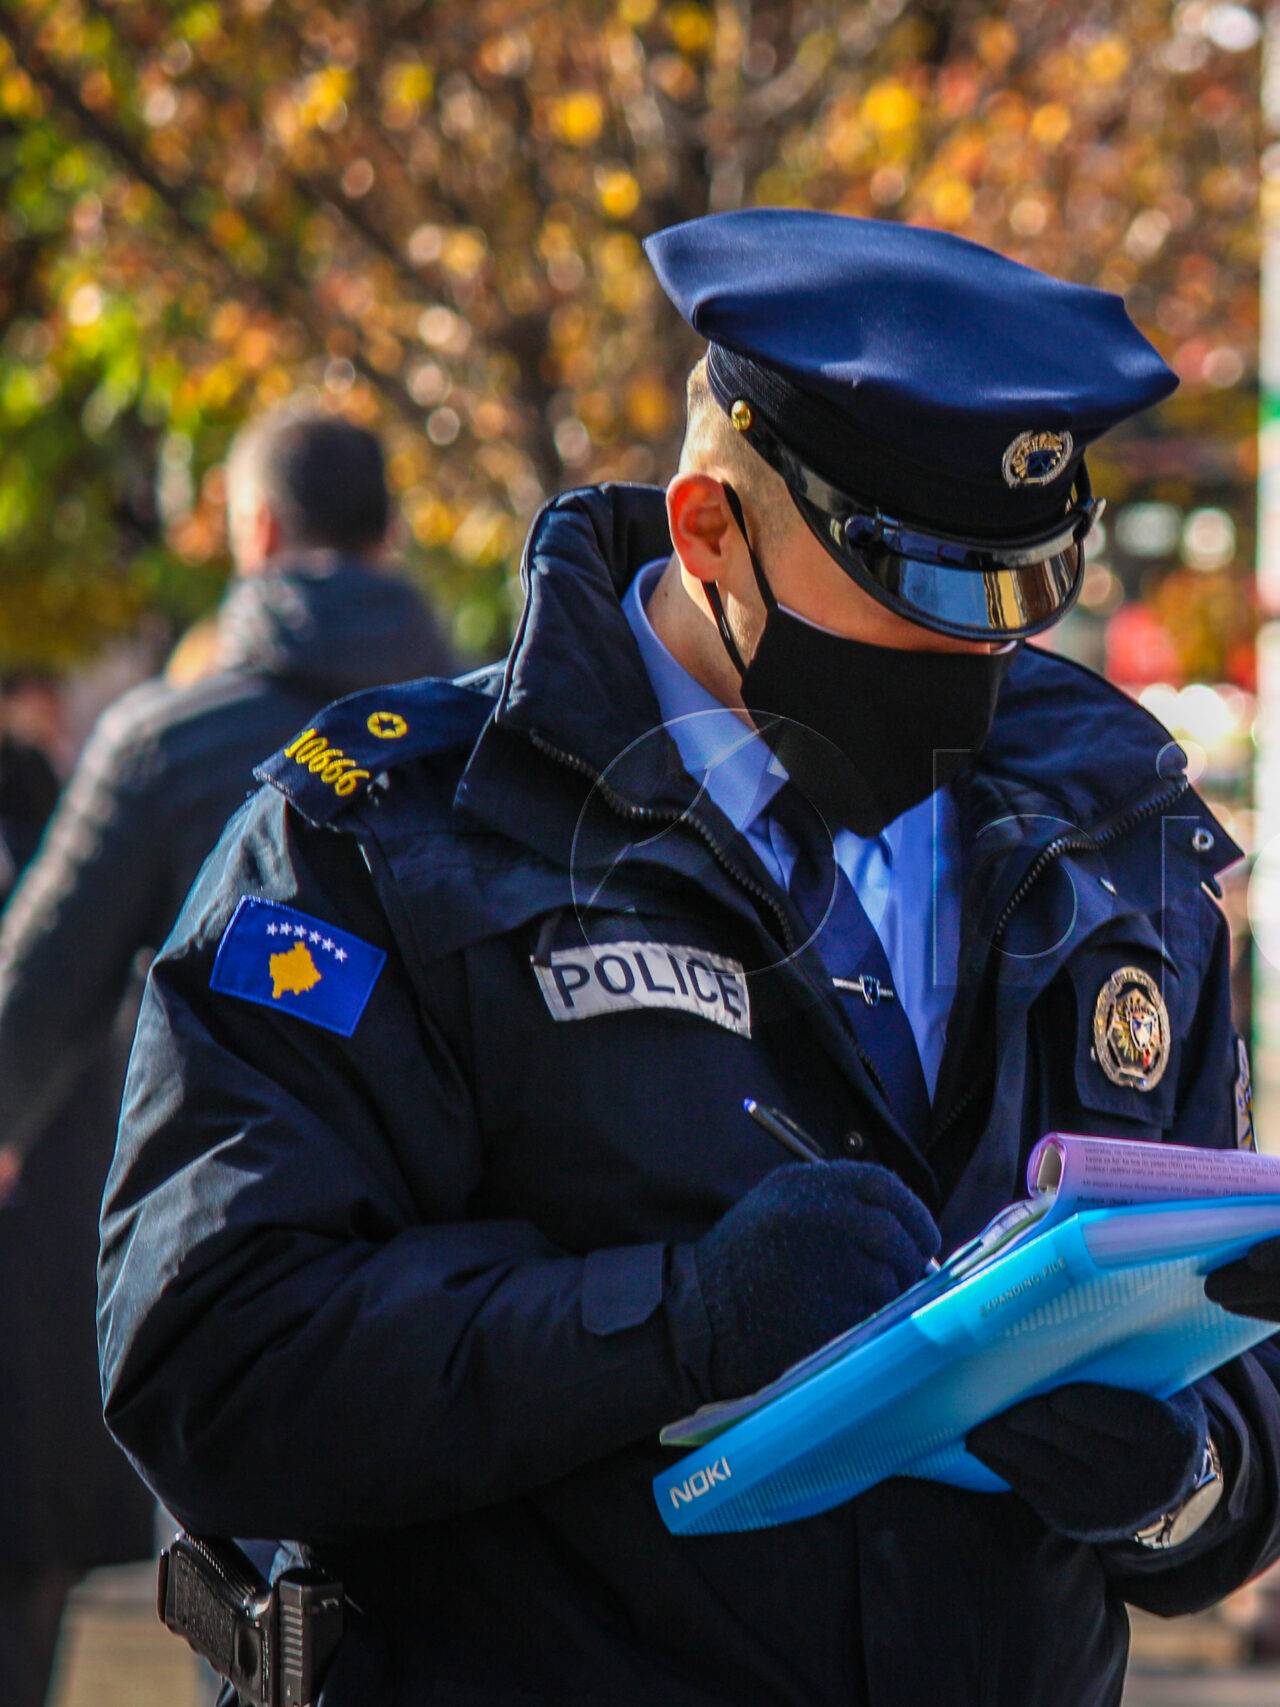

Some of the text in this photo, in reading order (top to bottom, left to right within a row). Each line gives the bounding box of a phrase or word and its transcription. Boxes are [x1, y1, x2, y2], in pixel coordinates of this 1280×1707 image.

[284, 728, 370, 796] 10666
[551, 951, 742, 1020] POLICE
[669, 1455, 732, 1509] NOKI
